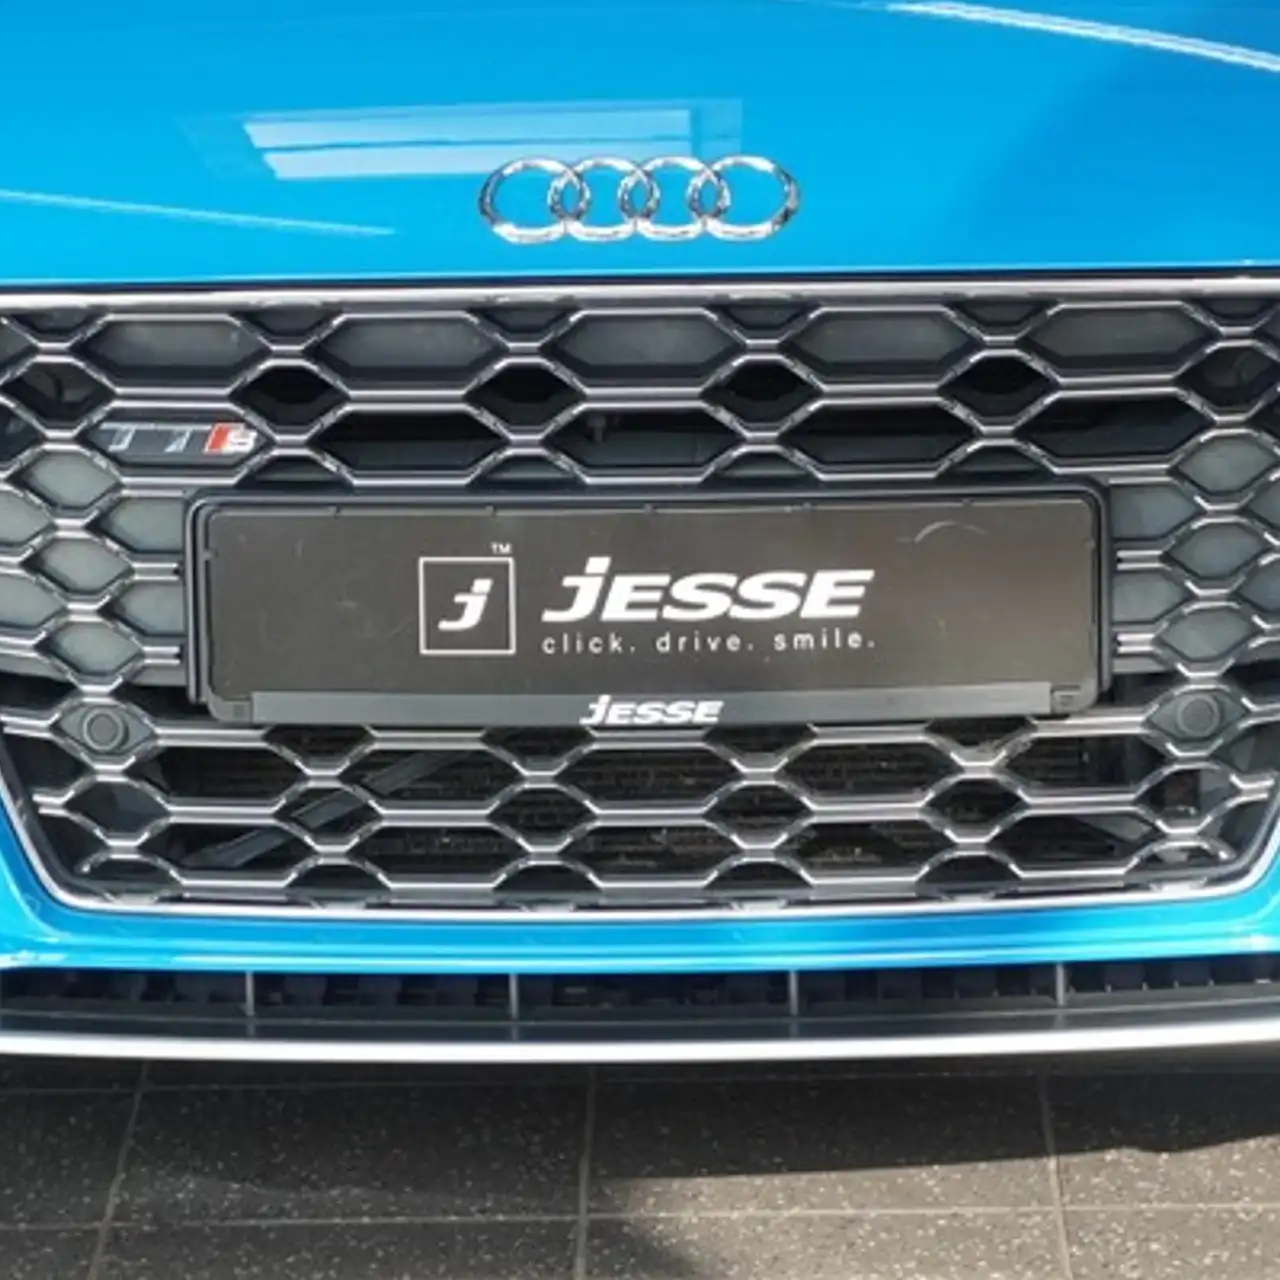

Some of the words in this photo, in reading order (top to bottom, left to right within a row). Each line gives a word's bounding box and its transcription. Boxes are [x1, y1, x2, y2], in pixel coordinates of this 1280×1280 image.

[541, 631, 636, 655] click.
[656, 630, 755, 653] drive.
[773, 626, 876, 651] smile.
